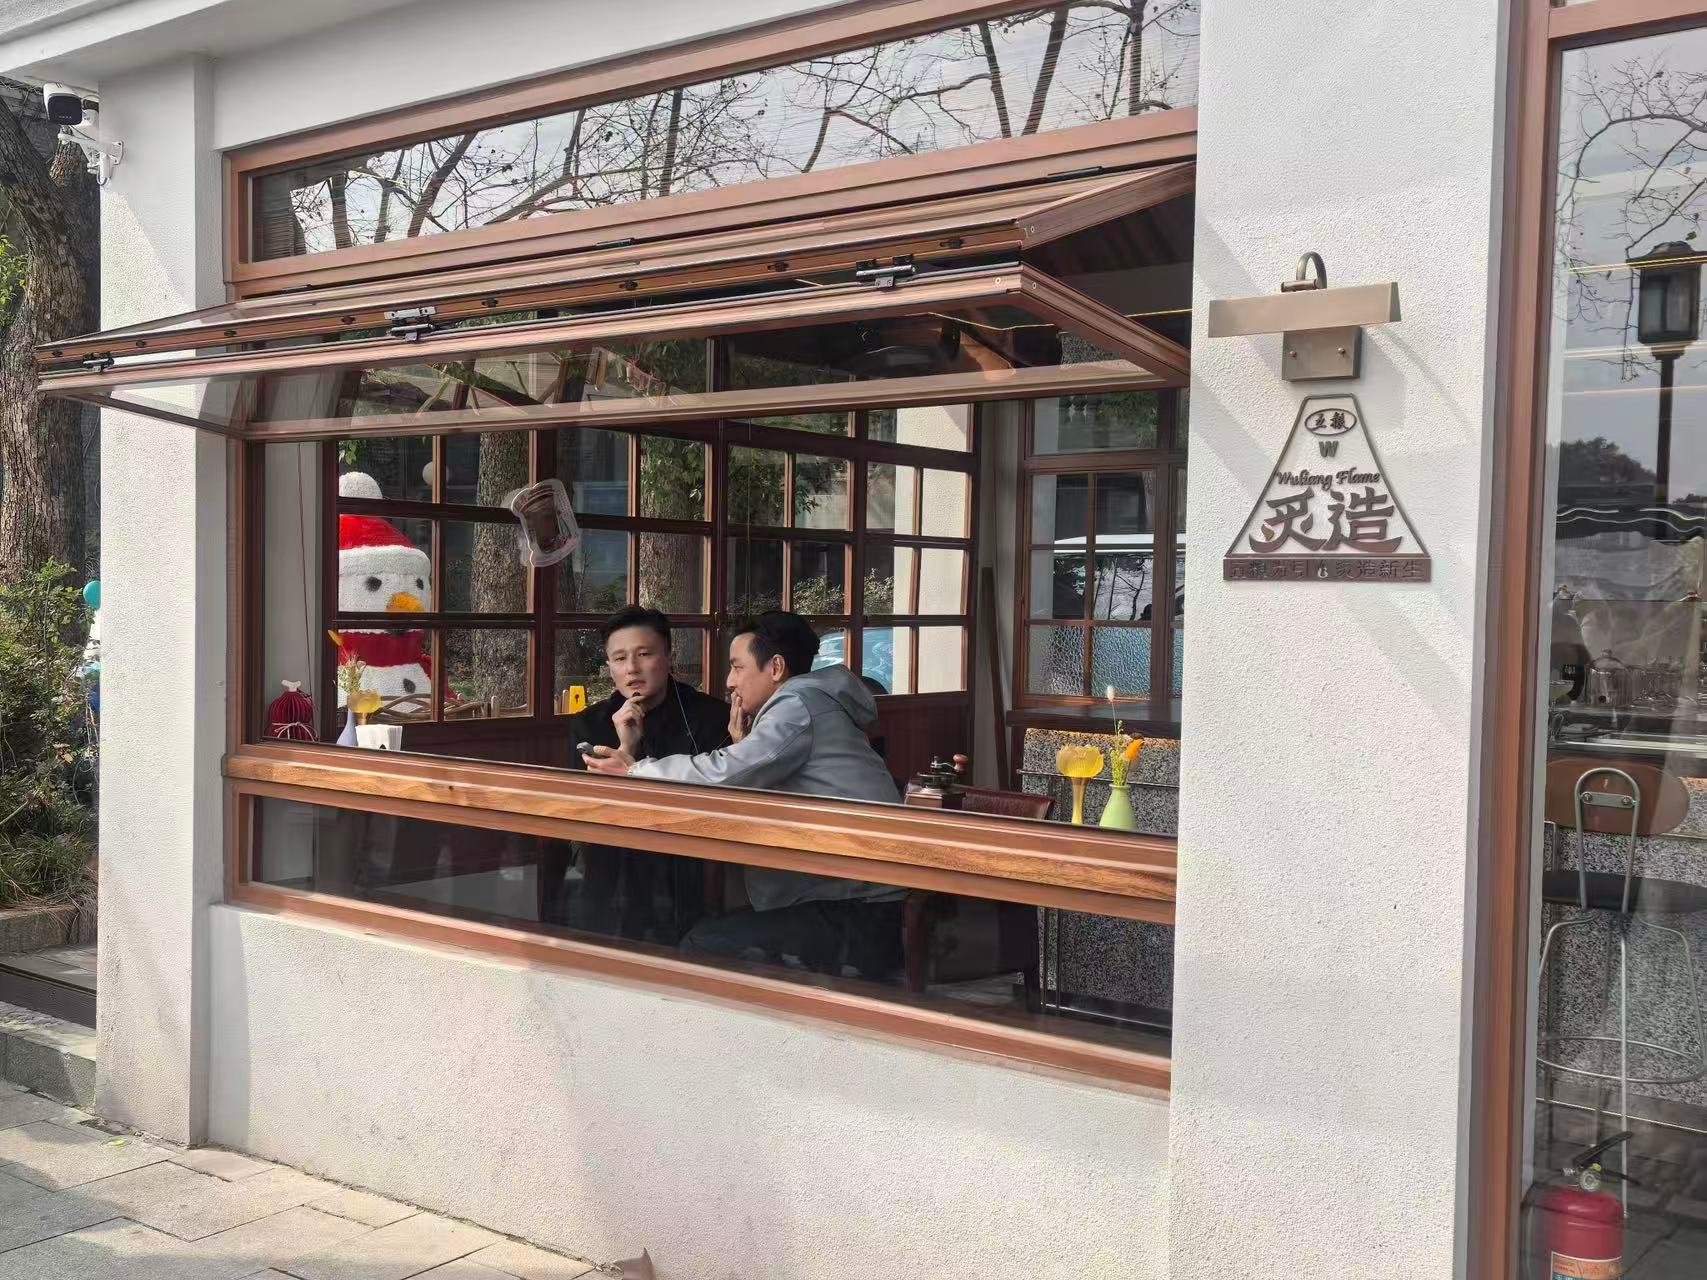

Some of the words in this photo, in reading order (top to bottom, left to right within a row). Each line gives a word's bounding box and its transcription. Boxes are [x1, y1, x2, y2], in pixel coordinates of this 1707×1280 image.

[1318, 440, 1339, 458] W
[1277, 469, 1333, 491] Wuliang
[1336, 467, 1381, 485] Flame
[1248, 485, 1403, 553] 炙造
